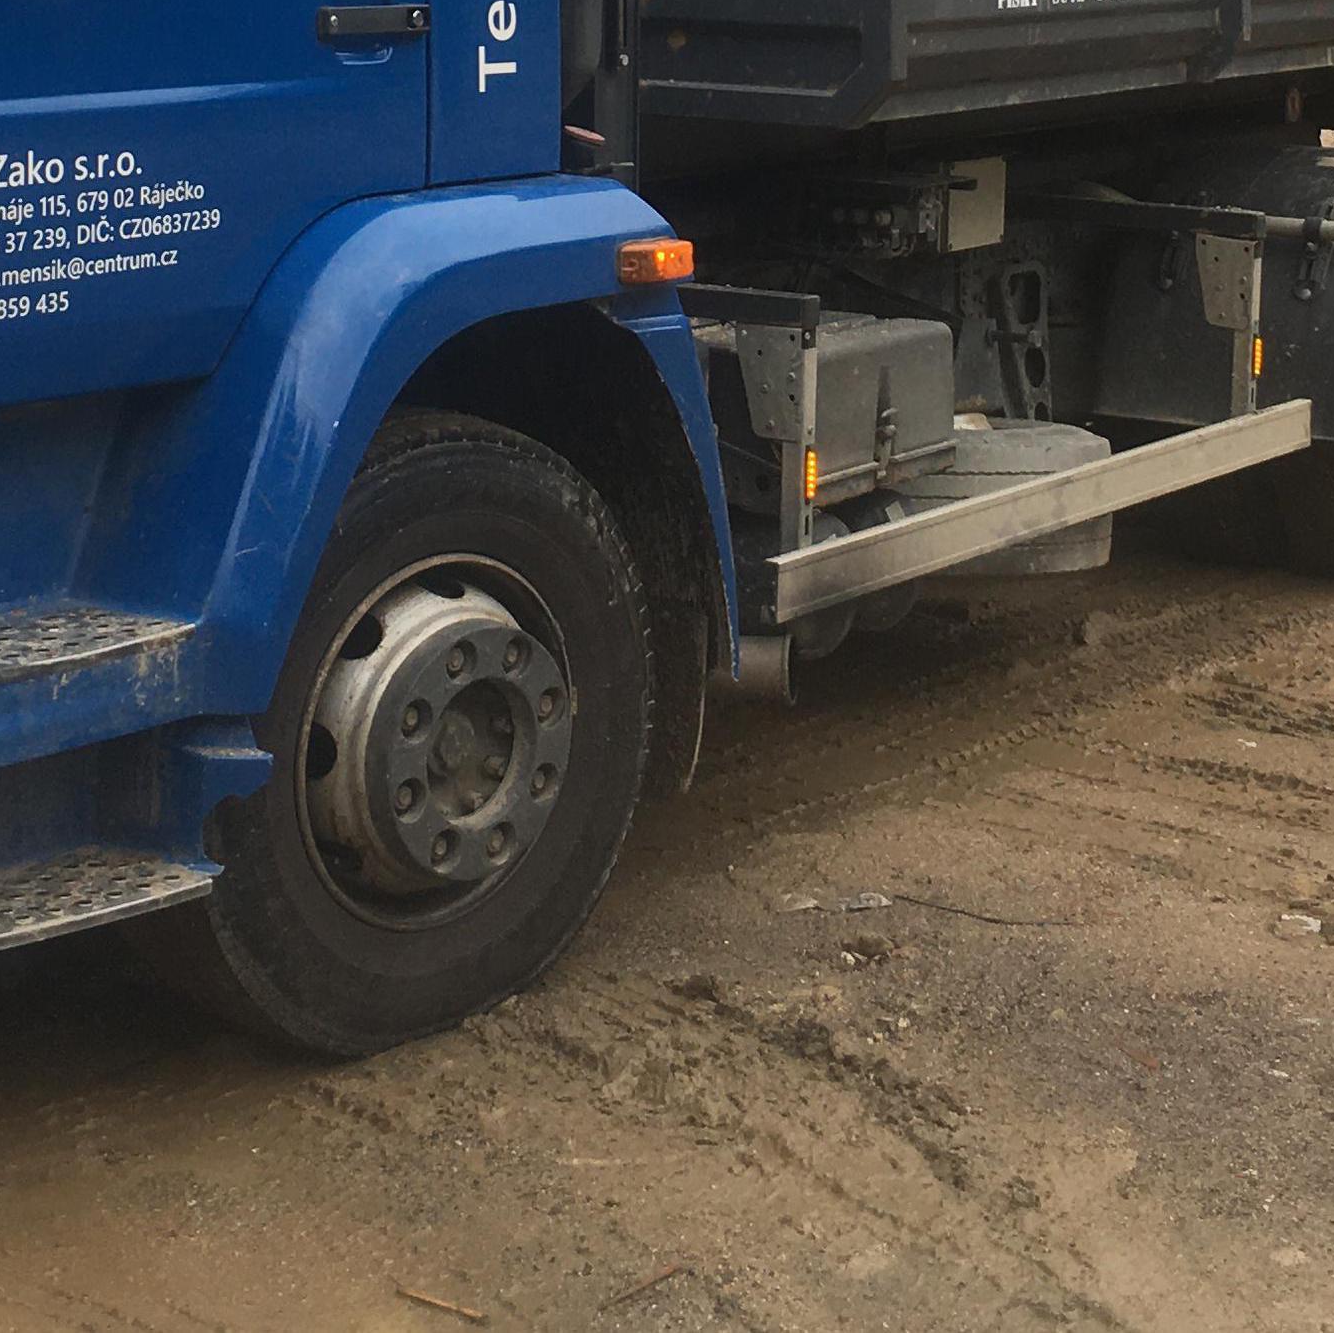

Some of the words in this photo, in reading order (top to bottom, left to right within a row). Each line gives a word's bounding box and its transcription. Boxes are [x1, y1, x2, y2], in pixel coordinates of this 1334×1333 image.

[74, 151, 143, 181] s.r.o.
[39, 194, 71, 217] 115,
[76, 190, 109, 213] 679
[113, 187, 134, 209] 02
[140, 180, 205, 209] Ráječko
[4, 231, 28, 254] 37
[32, 226, 71, 250] 239,
[77, 214, 114, 245] DIČ:
[119, 208, 221, 240] CZ06837239
[35, 290, 69, 314] 435
